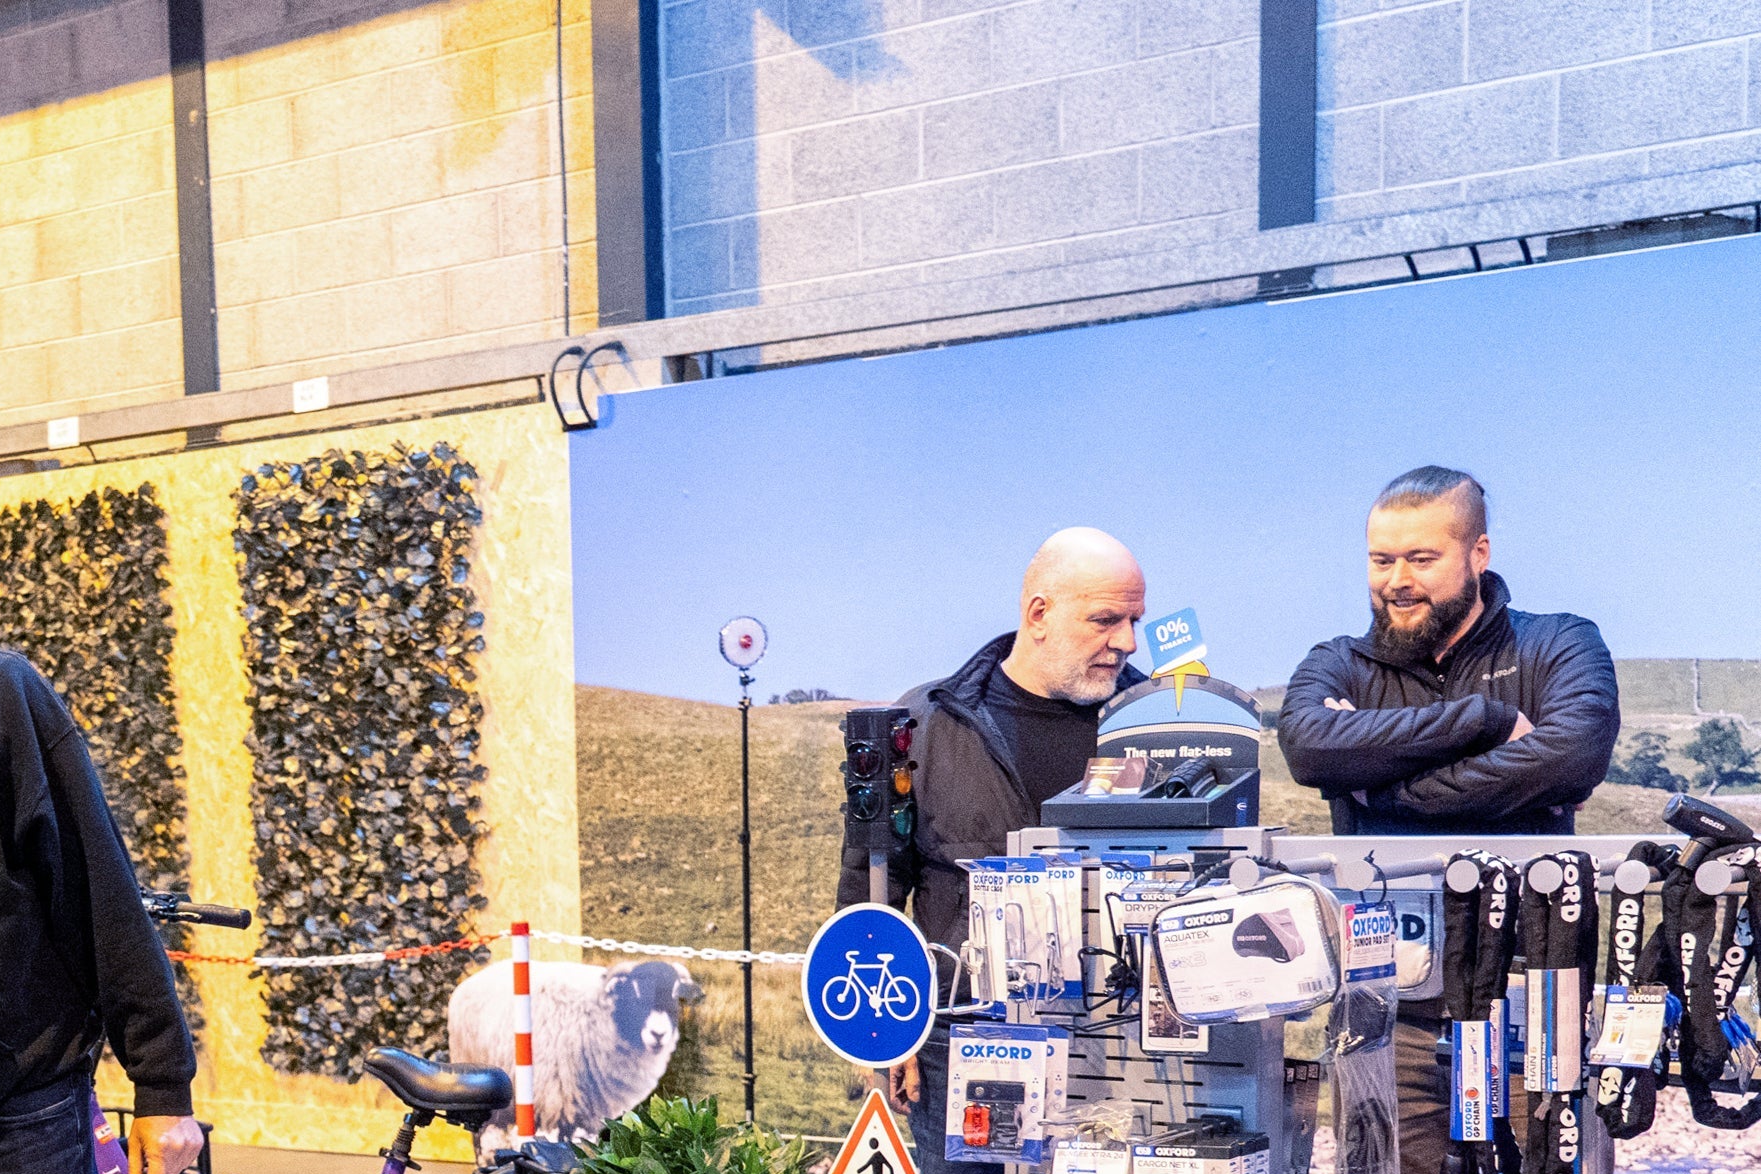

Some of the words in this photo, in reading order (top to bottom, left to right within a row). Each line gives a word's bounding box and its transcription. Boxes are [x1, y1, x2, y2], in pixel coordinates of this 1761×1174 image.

[1155, 617, 1190, 643] 0%
[1159, 634, 1193, 652] FINANCE
[1124, 746, 1147, 758] The
[1150, 748, 1176, 758] new
[1179, 745, 1232, 757] flat-less
[1008, 875, 1039, 884] FORD
[1048, 870, 1074, 879] FORD
[1106, 871, 1146, 881] OXFORD
[973, 875, 1004, 886] OXFORD
[1556, 852, 1582, 923] FORD
[1140, 893, 1176, 901] OXFORD
[1184, 912, 1230, 927] OXFORD
[1353, 916, 1391, 937] OXFORD
[1163, 930, 1210, 943] AQUATEX
[1354, 937, 1372, 947] JUNIOR
[1372, 936, 1382, 945] PAD
[1627, 994, 1662, 1003] OXFORD
[961, 1045, 1032, 1060] OXFORD
[1473, 1101, 1481, 1125] CHAIN
[1492, 1104, 1499, 1115] GP
[1465, 1101, 1473, 1138] OXFORD
[1473, 1127, 1481, 1138] GP
[1155, 1148, 1197, 1157] OXFORD
[1189, 1162, 1200, 1170] XL
